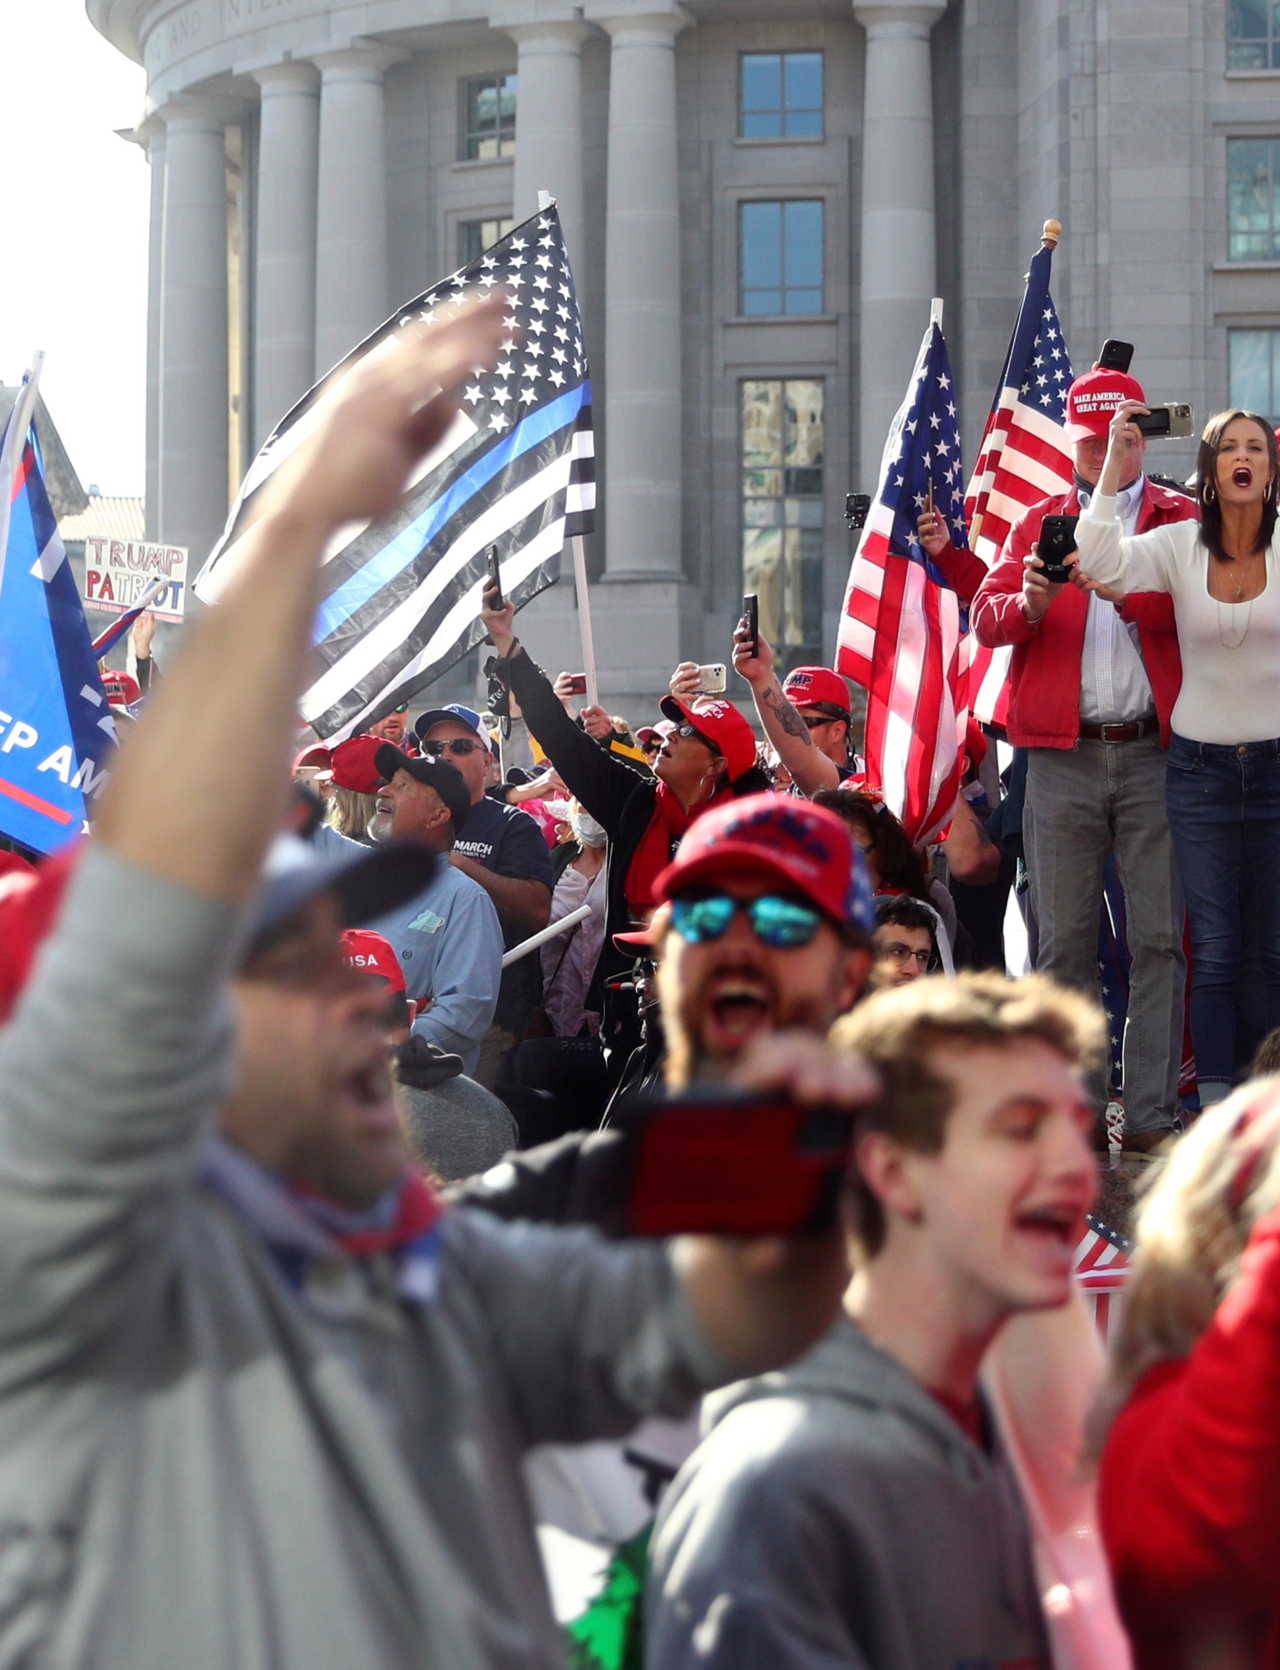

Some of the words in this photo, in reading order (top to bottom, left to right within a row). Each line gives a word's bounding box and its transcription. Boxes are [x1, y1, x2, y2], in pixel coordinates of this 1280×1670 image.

[1073, 393, 1092, 405] MAKE
[1092, 392, 1126, 401] AMERICA
[1076, 402, 1098, 413] GREAT
[89, 538, 185, 577] TRUMP
[87, 569, 184, 610] PATROT
[453, 839, 493, 855] MARCH
